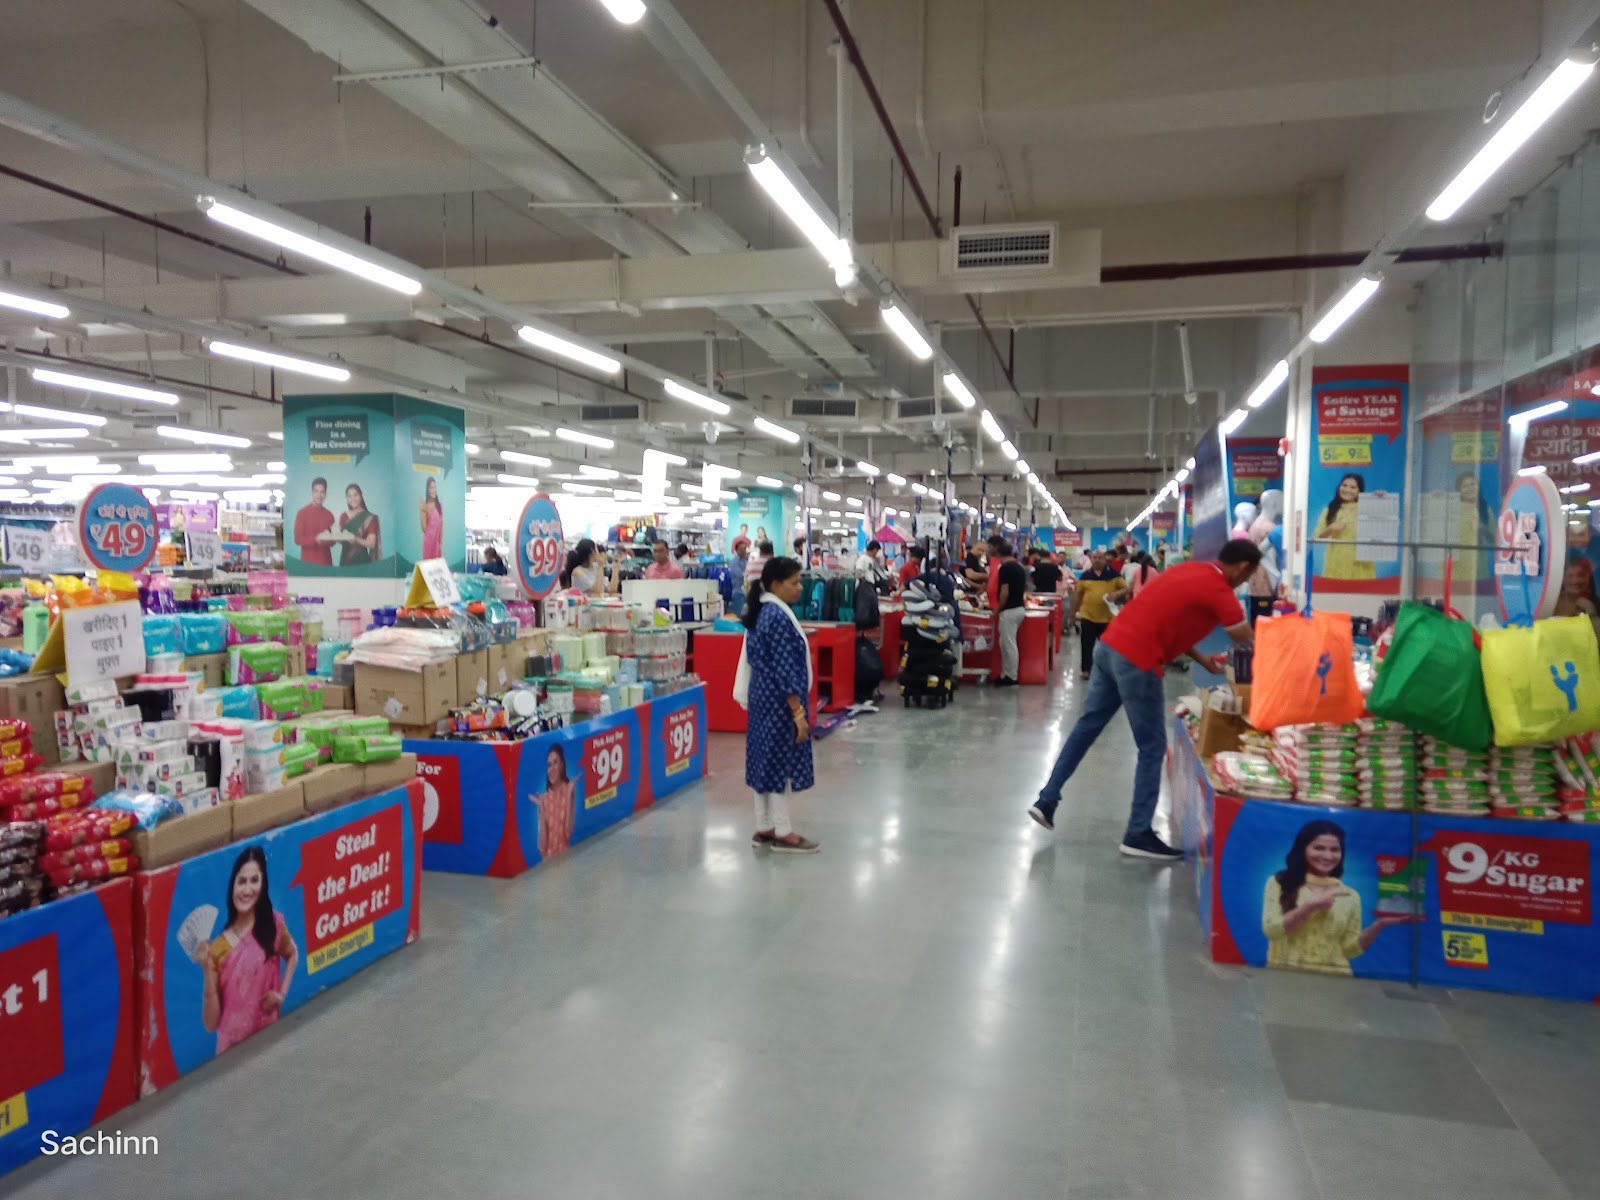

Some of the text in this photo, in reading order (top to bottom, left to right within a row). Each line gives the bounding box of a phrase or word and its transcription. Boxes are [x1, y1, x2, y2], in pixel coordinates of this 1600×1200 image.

[1323, 394, 1397, 405] Entire YEAR
[1324, 405, 1395, 418] of Savings
[315, 419, 361, 429] Fine dining
[310, 440, 367, 450] Fine Crockery
[82, 612, 127, 633] खरीदिए 1
[91, 633, 123, 652] पाइए 1
[592, 730, 624, 749] Pick Any For
[416, 761, 442, 776] For
[334, 822, 377, 860] Steal
[316, 850, 391, 904] the Deal!
[1484, 865, 1585, 895] Sugar
[315, 883, 391, 940] Go for it!
[1451, 914, 1472, 924] This
[1473, 916, 1484, 925] is
[1446, 939, 1459, 958] 5
[31, 967, 49, 1003] 1
